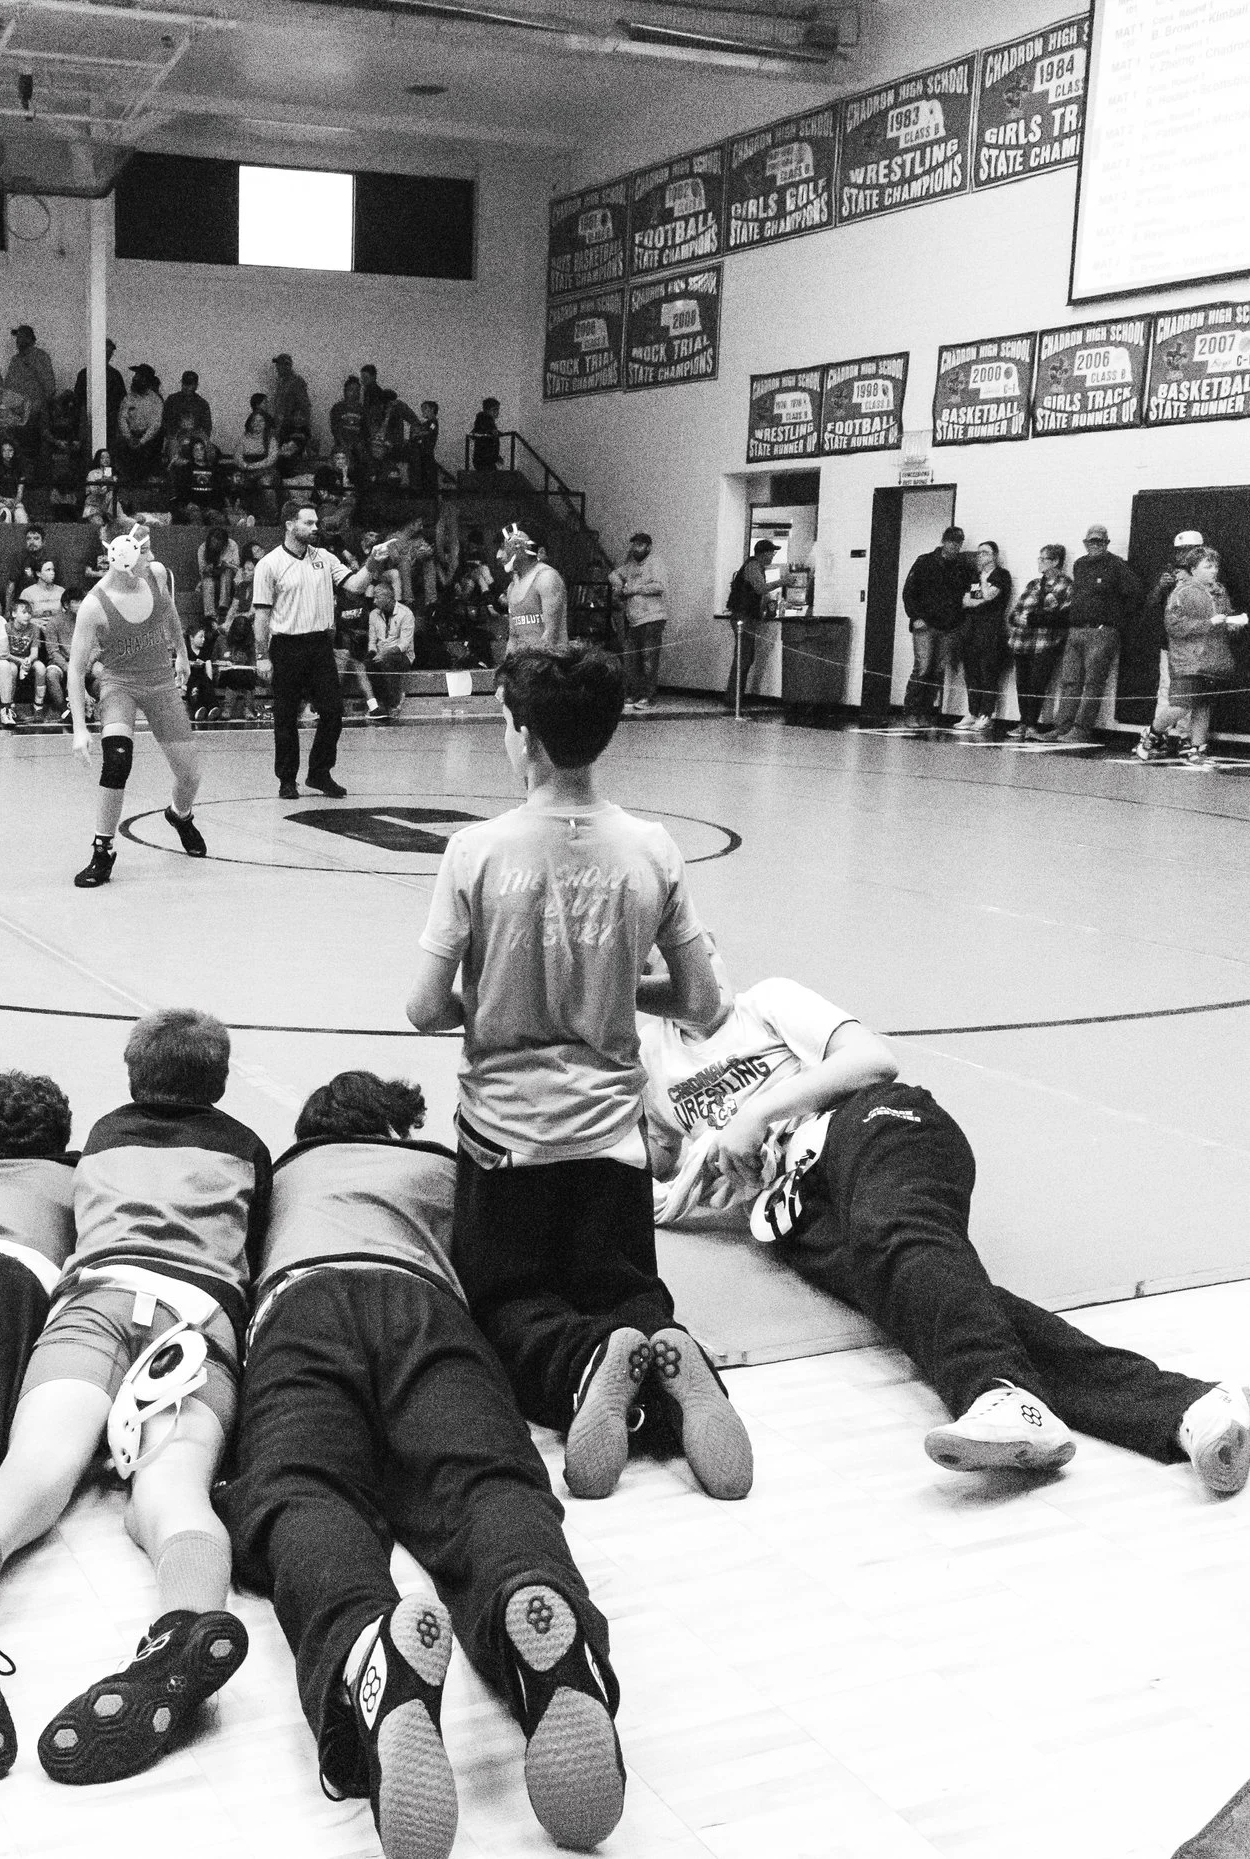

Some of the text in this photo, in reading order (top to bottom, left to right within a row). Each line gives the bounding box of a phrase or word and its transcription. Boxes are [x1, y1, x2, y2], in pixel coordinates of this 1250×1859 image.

[1114, 24, 1136, 40] MAT
[1165, 20, 1199, 37] Brown
[1209, 4, 1249, 24] Kimball
[985, 37, 1044, 89] CHADRON
[1049, 25, 1078, 52] HIGH
[1039, 54, 1075, 85] 1984
[847, 63, 970, 133] CHADRON HIGH SCHOOL
[889, 106, 920, 133] 1983
[984, 114, 1042, 145] GIRLS
[904, 126, 931, 145] CLASS
[849, 138, 959, 185] WRESTLING
[979, 147, 1024, 181] STATE
[731, 177, 828, 219] GIRLS GOLF
[842, 153, 962, 217] STATE CHAMPIONS
[634, 211, 717, 249] FOOTBALL
[729, 191, 829, 247] STATE CHAMPIONS
[1041, 321, 1145, 361] CHADRON HIGH SCHOOL
[1156, 311, 1205, 345] CHADRON
[1208, 307, 1232, 325] HIGH
[632, 343, 667, 363] MOCK
[673, 334, 711, 361] TRIAL
[1198, 334, 1236, 356] 2007
[628, 347, 714, 385] STATE CHAMPIONS
[1076, 351, 1110, 371] 2006
[1090, 370, 1117, 384] CLASS
[1158, 374, 1250, 401] BASKETBAL
[941, 401, 1022, 425] BASKETBALL
[1036, 397, 1138, 431] STATE RUNNER UP
[1043, 386, 1133, 412] GIRLS TRACK
[1149, 395, 1245, 421] STATE RUNNER
[754, 422, 814, 443] WRESTLING
[826, 415, 899, 436] FOOTBALL
[936, 412, 1025, 441] STATE RUNNER UP
[749, 431, 818, 457] STATE RUNNER UP
[824, 432, 848, 451] STATE
[851, 431, 885, 448] RUNNER
[673, 1056, 771, 1133] WRESTLING
